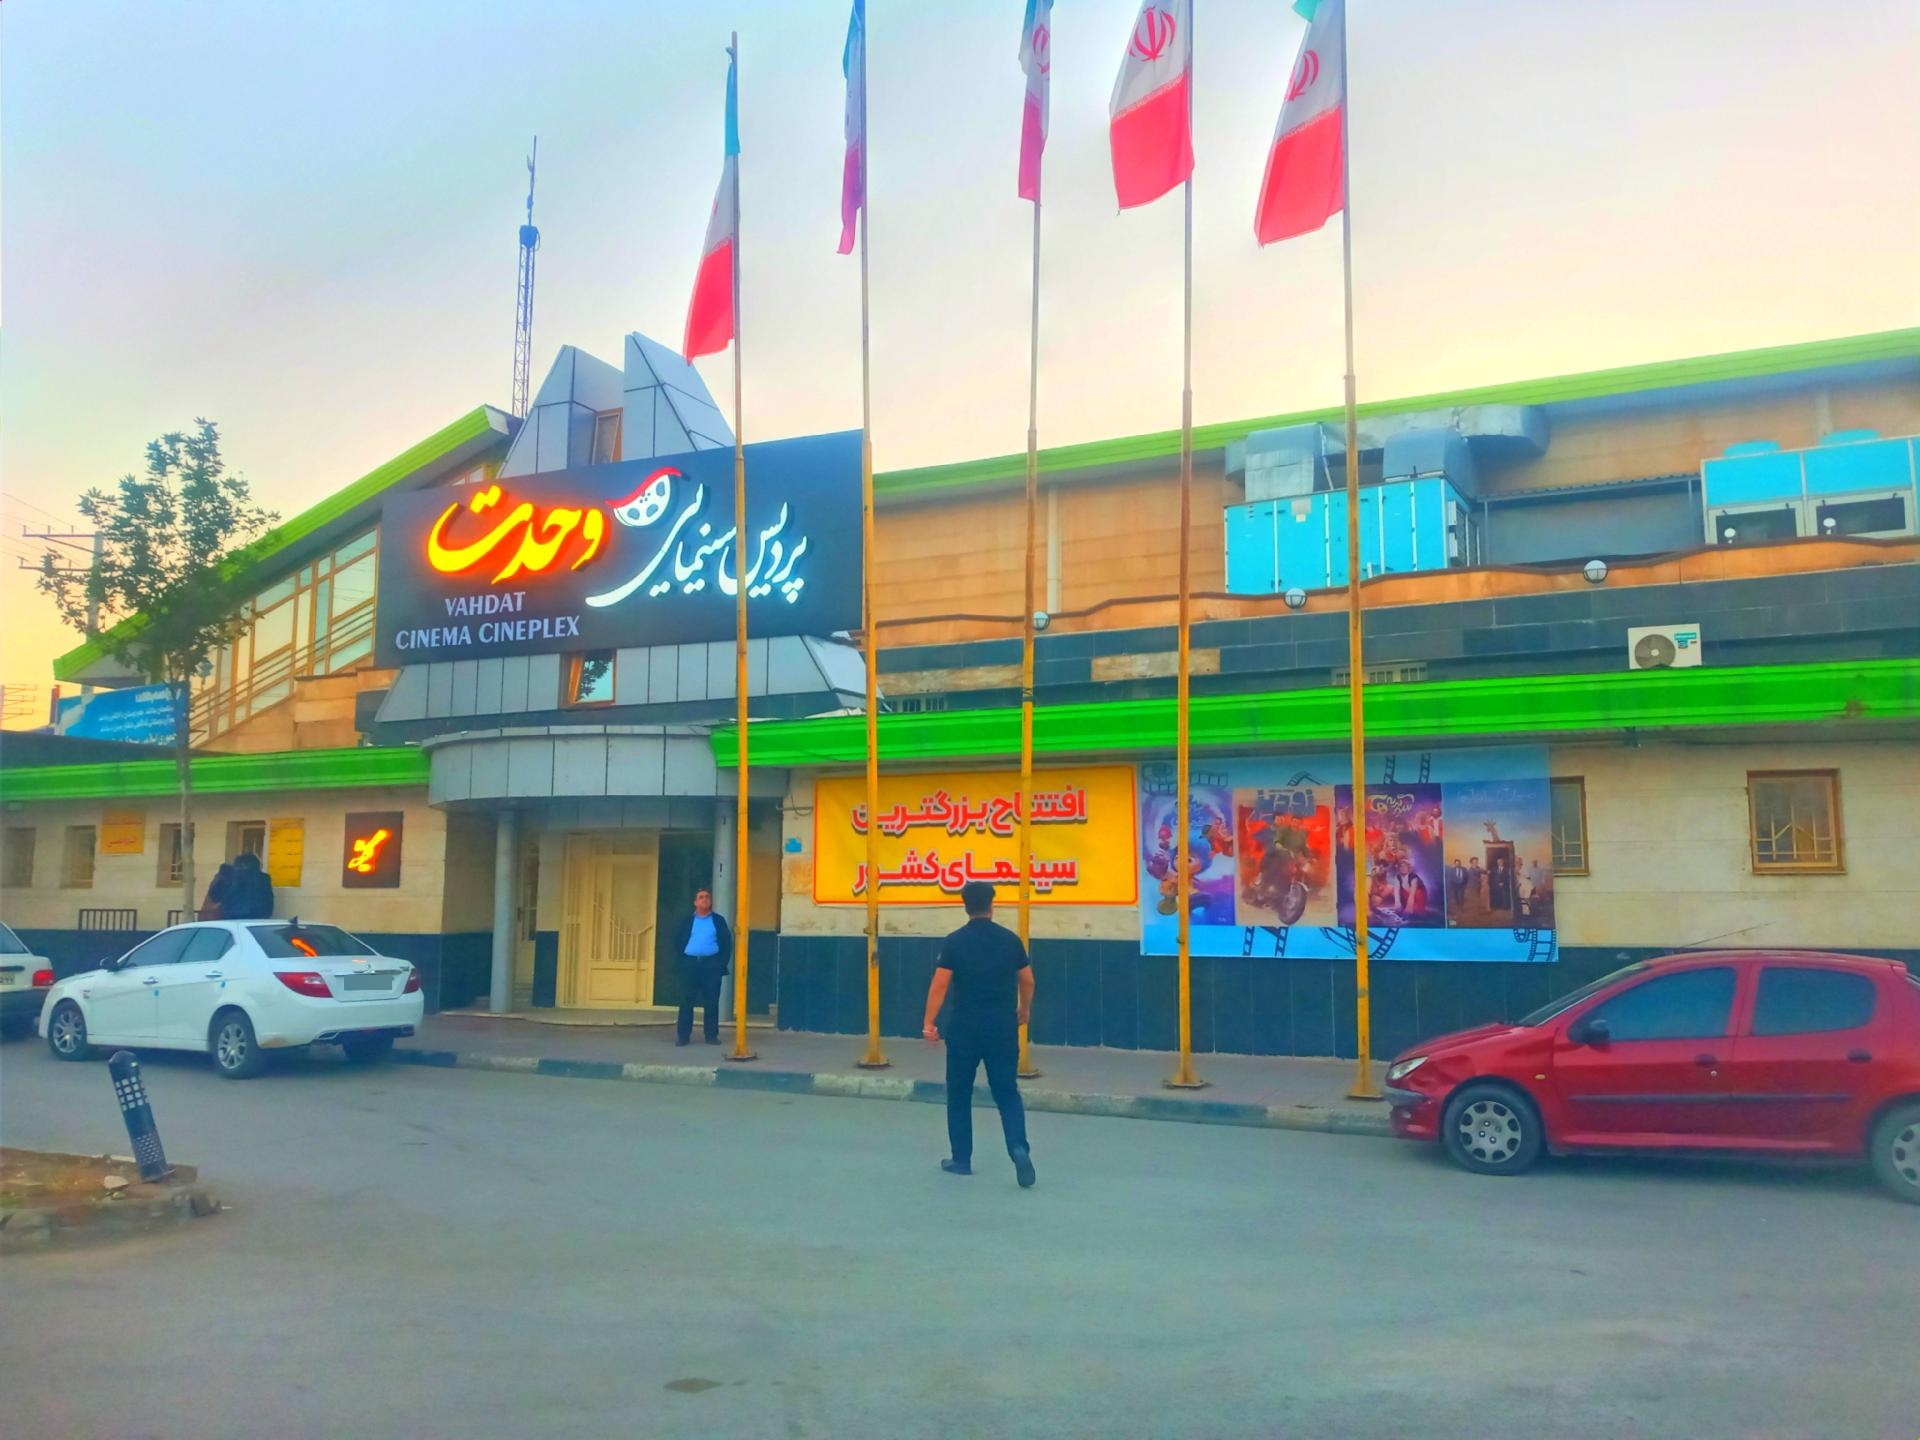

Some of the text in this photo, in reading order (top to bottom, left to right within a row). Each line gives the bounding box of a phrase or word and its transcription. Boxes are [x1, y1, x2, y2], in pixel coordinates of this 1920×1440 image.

[428, 485, 604, 585] وحدت
[719, 501, 808, 604] پردیس
[444, 591, 526, 616] VAHDAT
[395, 615, 580, 650] CINEMA CINEPLEX
[852, 784, 1086, 832] افتتاح بزرگترین
[854, 848, 942, 890] کشر
